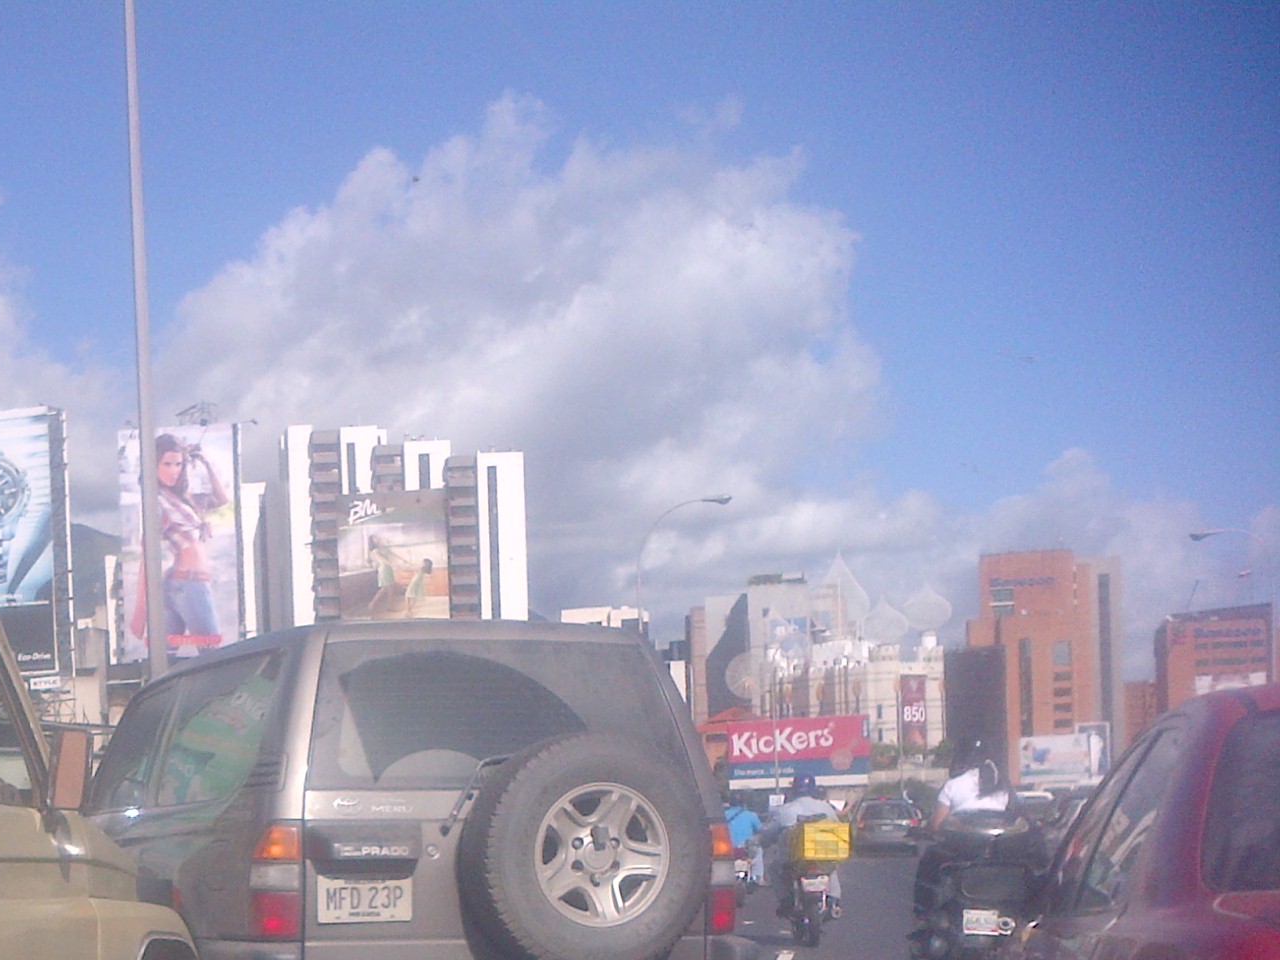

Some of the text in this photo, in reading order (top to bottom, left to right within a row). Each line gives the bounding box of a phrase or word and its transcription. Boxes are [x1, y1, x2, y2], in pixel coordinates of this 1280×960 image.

[903, 706, 926, 722] 850
[361, 846, 409, 856] PRADO
[326, 885, 404, 911] MFD 23P
